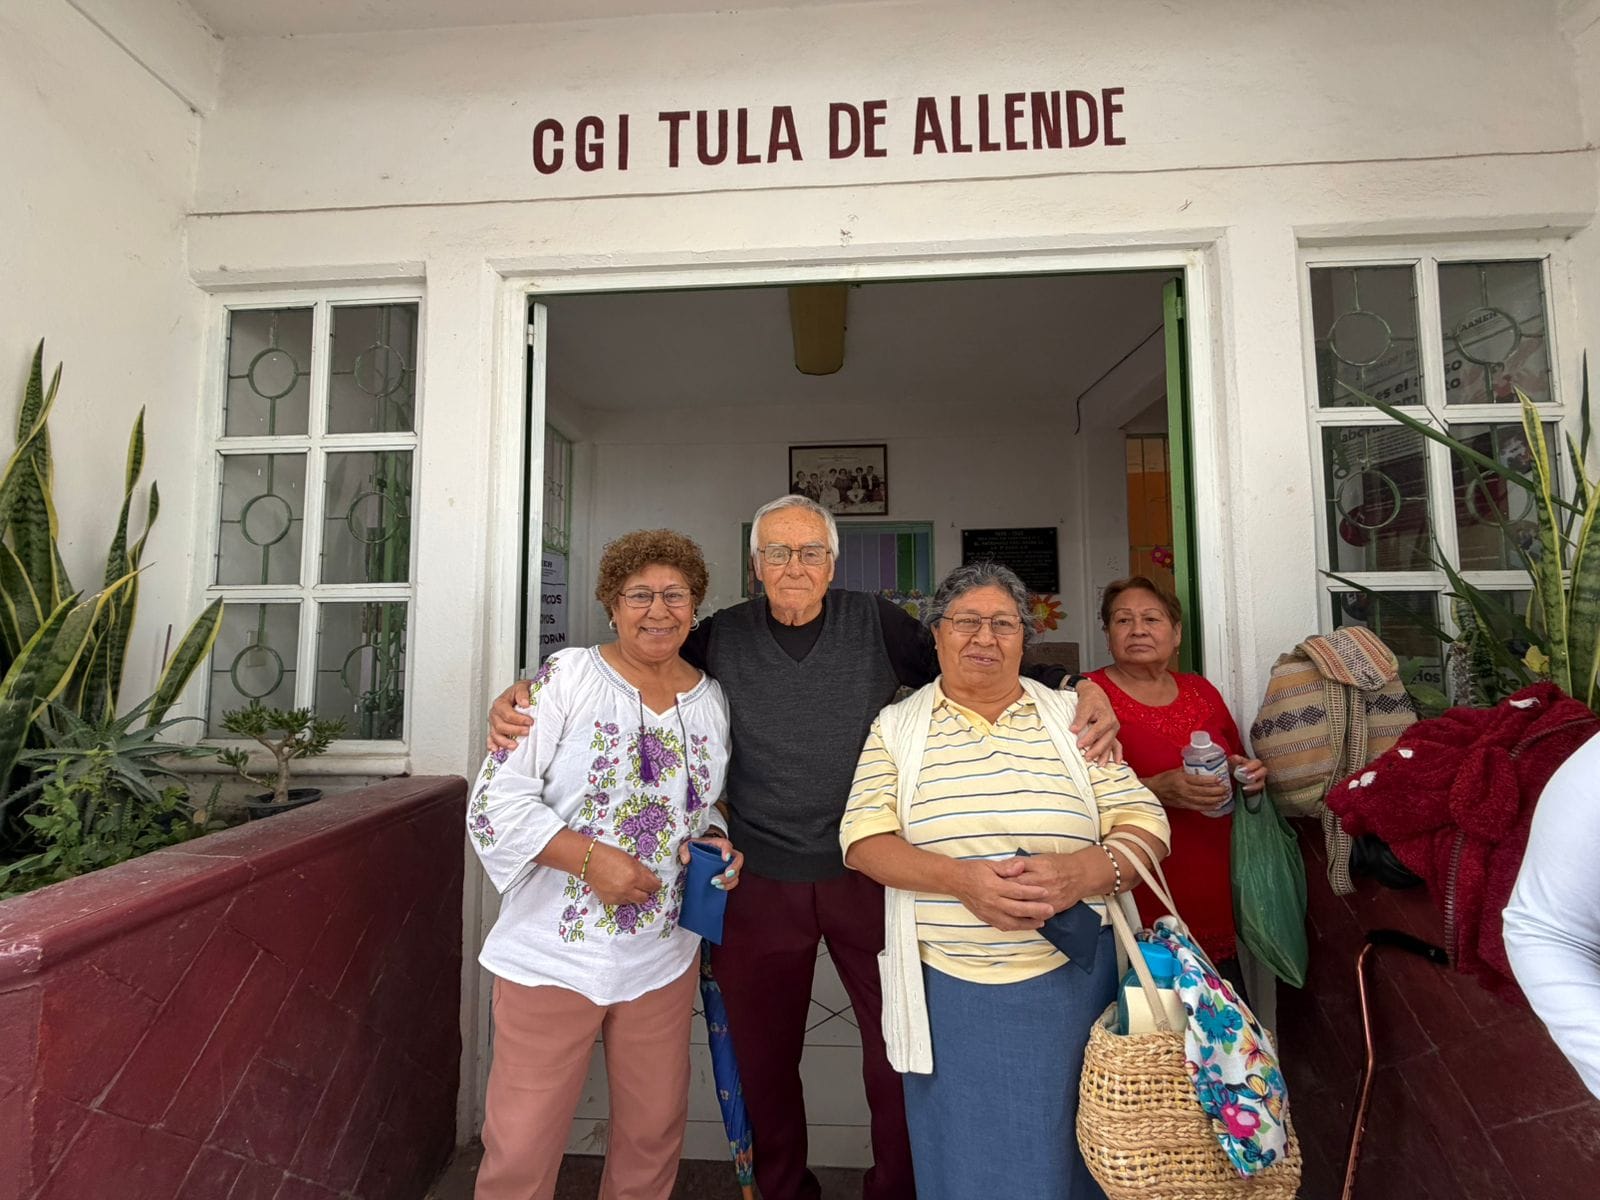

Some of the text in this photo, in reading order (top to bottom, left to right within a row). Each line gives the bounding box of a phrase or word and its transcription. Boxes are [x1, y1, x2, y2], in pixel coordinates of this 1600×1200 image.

[533, 87, 1126, 174] CGI TULA DE ALLENDE
